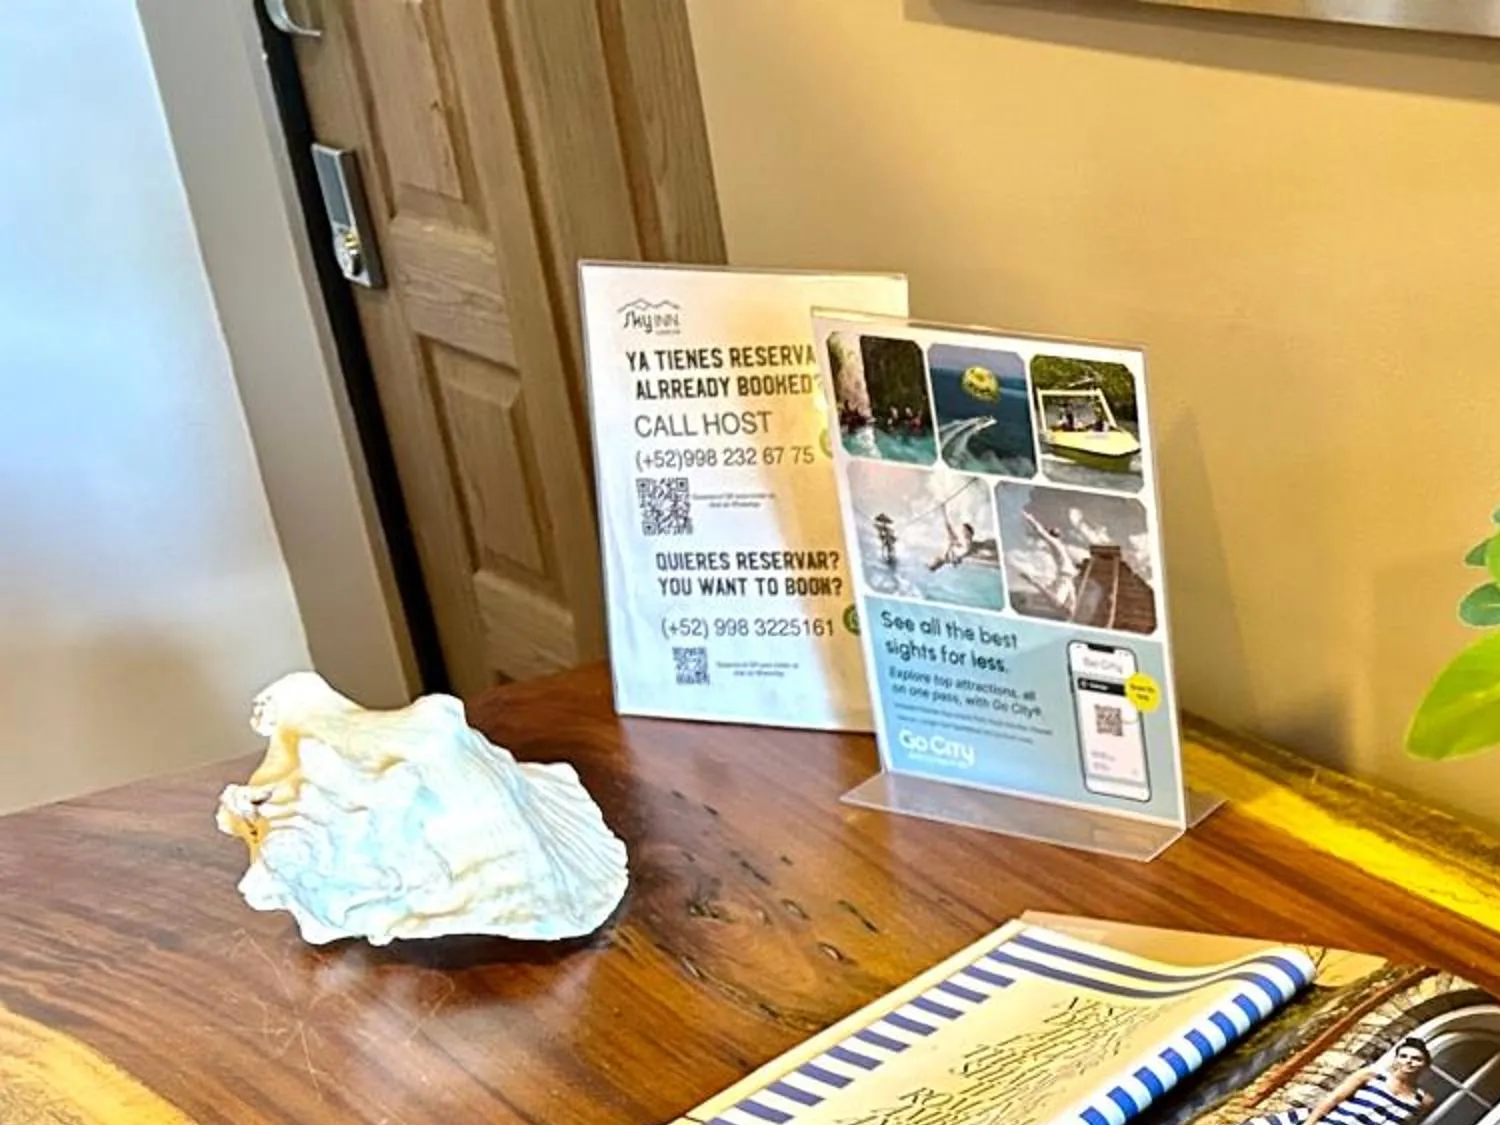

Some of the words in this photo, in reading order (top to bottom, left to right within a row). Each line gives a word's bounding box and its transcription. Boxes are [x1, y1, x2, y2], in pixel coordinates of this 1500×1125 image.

[626, 351, 650, 371] YA
[655, 347, 724, 370] TIENES
[636, 376, 730, 400] ALRREADY
[635, 413, 698, 438] CALL
[702, 411, 772, 435] HOST
[635, 448, 717, 472] (+52)998
[723, 447, 757, 467] 232
[763, 447, 784, 466] 67
[792, 446, 814, 465] 75
[656, 551, 731, 571] QUIERES
[736, 551, 840, 570] RESERVAR?
[658, 578, 692, 596] YOU
[698, 577, 748, 596] WANT
[755, 577, 778, 596] TO
[785, 577, 843, 596] BOOK?
[661, 617, 709, 639] (+52)
[714, 618, 749, 636] 998
[755, 618, 834, 637] 3225161
[881, 610, 915, 632] See
[920, 617, 941, 637] all
[946, 620, 975, 641] the
[979, 626, 1018, 649] best
[885, 638, 937, 662] sights
[940, 645, 966, 667] for
[971, 651, 1009, 673] less.
[889, 666, 931, 684] Explore
[934, 674, 953, 688] top
[956, 679, 1020, 700] attractions,
[892, 683, 907, 695] on
[909, 686, 930, 700] one
[932, 690, 962, 706] pass,
[965, 695, 990, 709] with
[993, 699, 1009, 713] Go
[898, 728, 929, 752] Go
